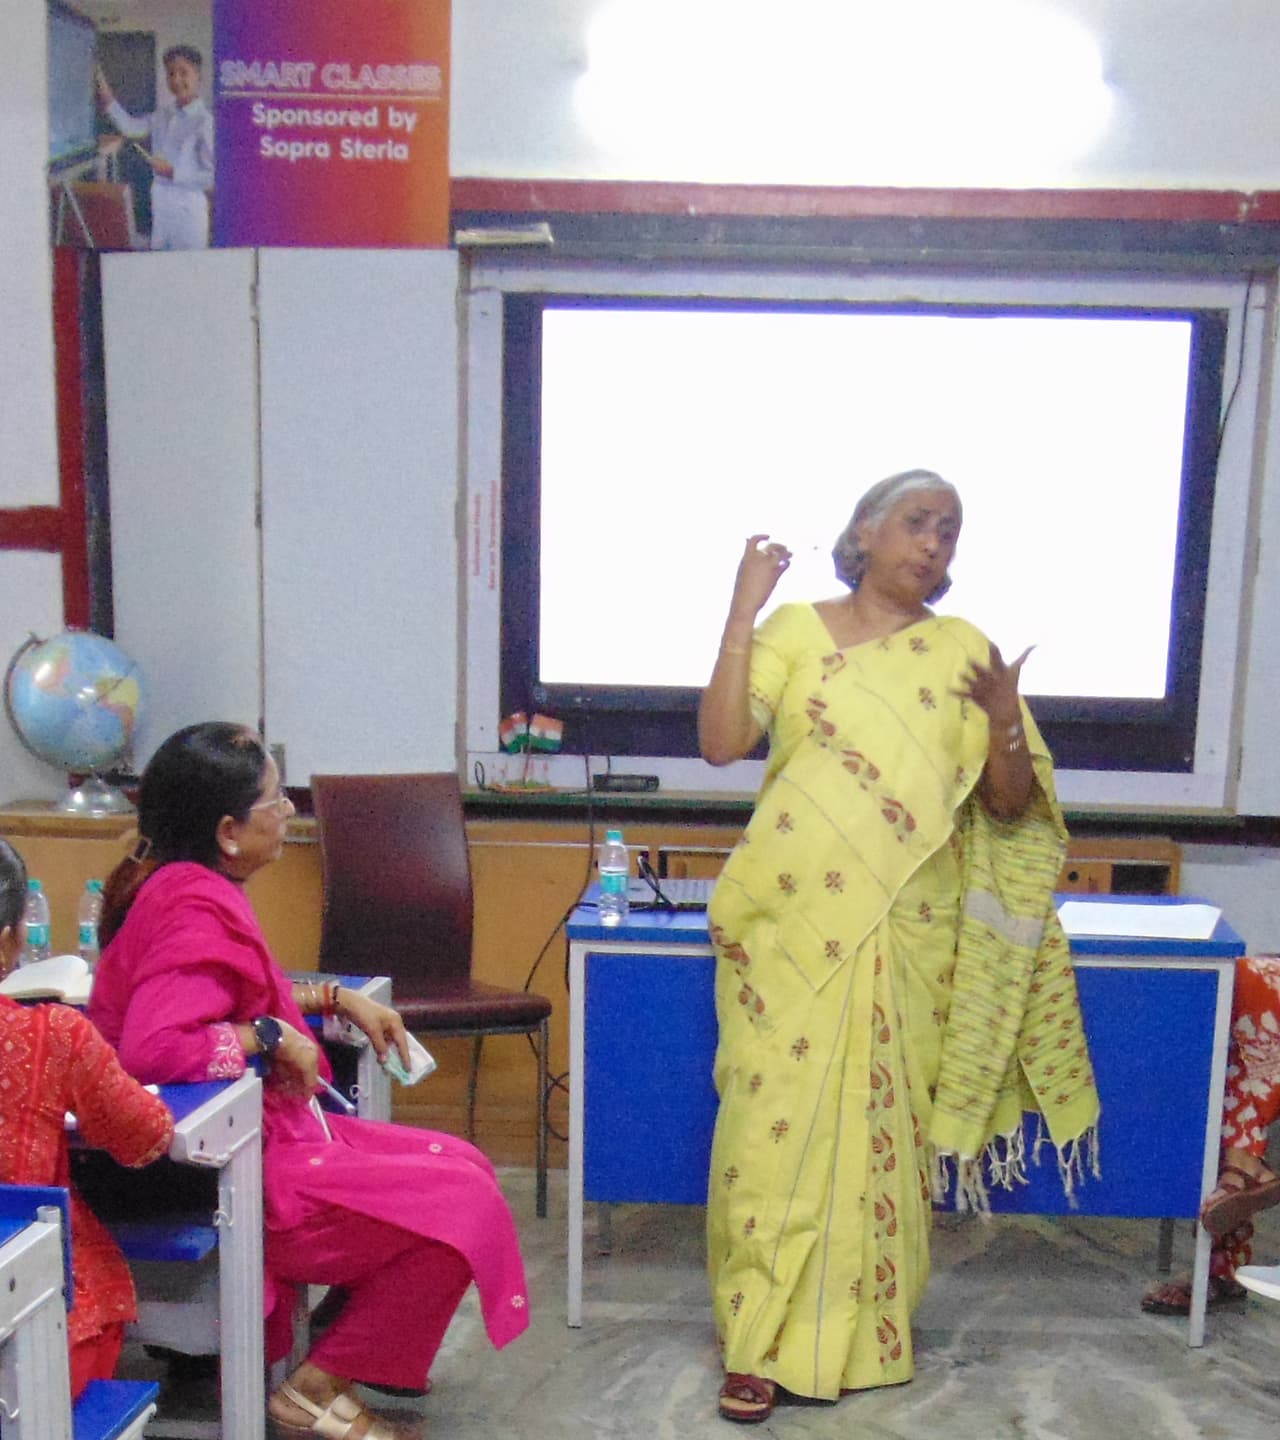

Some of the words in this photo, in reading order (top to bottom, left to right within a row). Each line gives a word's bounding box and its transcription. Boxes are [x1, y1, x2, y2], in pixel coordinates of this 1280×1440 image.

[220, 60, 314, 87] SMART
[321, 63, 441, 91] CLASSES
[252, 103, 378, 129] Sponsored
[388, 106, 417, 132] by
[260, 136, 330, 162] Sopra
[340, 139, 409, 160] Steria
